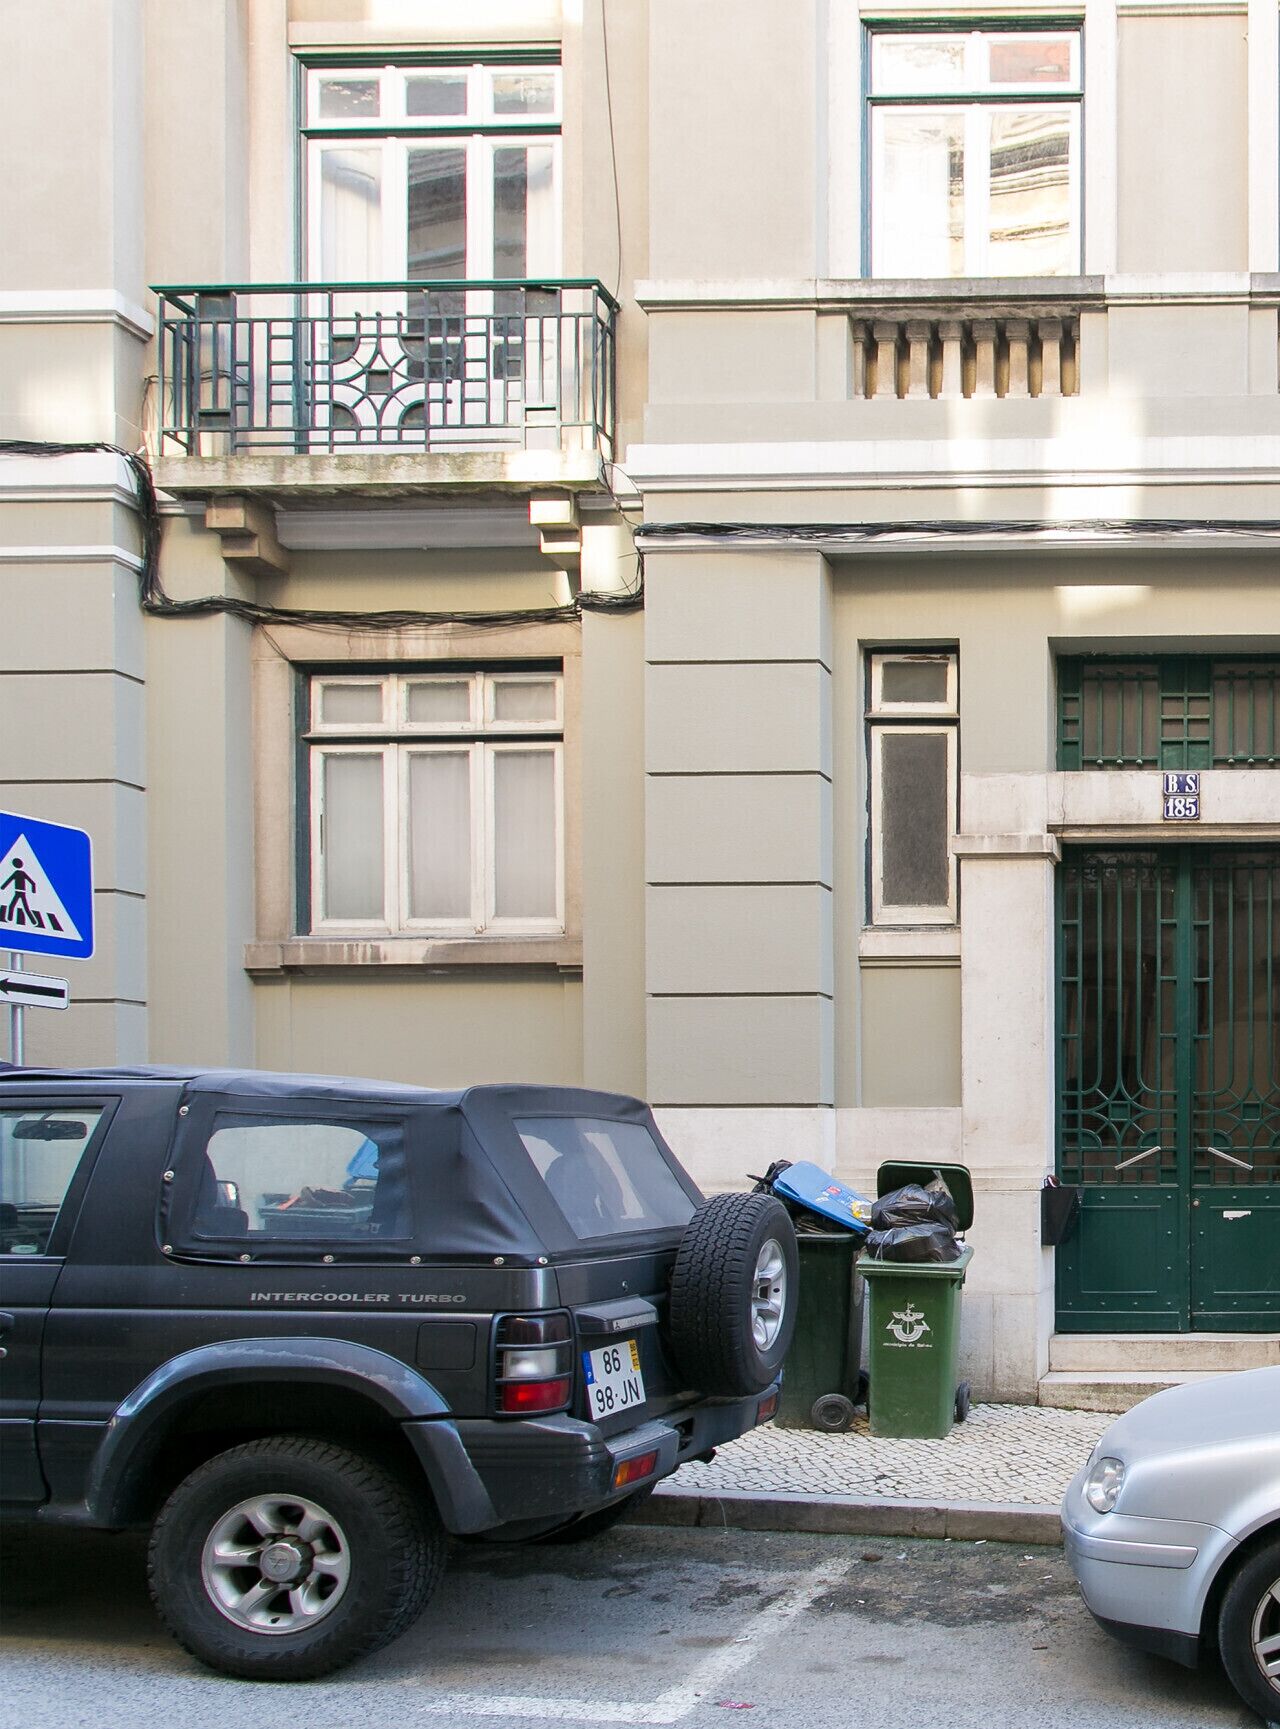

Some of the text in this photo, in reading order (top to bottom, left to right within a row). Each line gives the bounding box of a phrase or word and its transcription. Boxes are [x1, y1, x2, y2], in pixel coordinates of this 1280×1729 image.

[1167, 798, 1196, 817] 185
[251, 1292, 467, 1304] INTERCOOLER TURBO
[603, 1348, 620, 1374] 86
